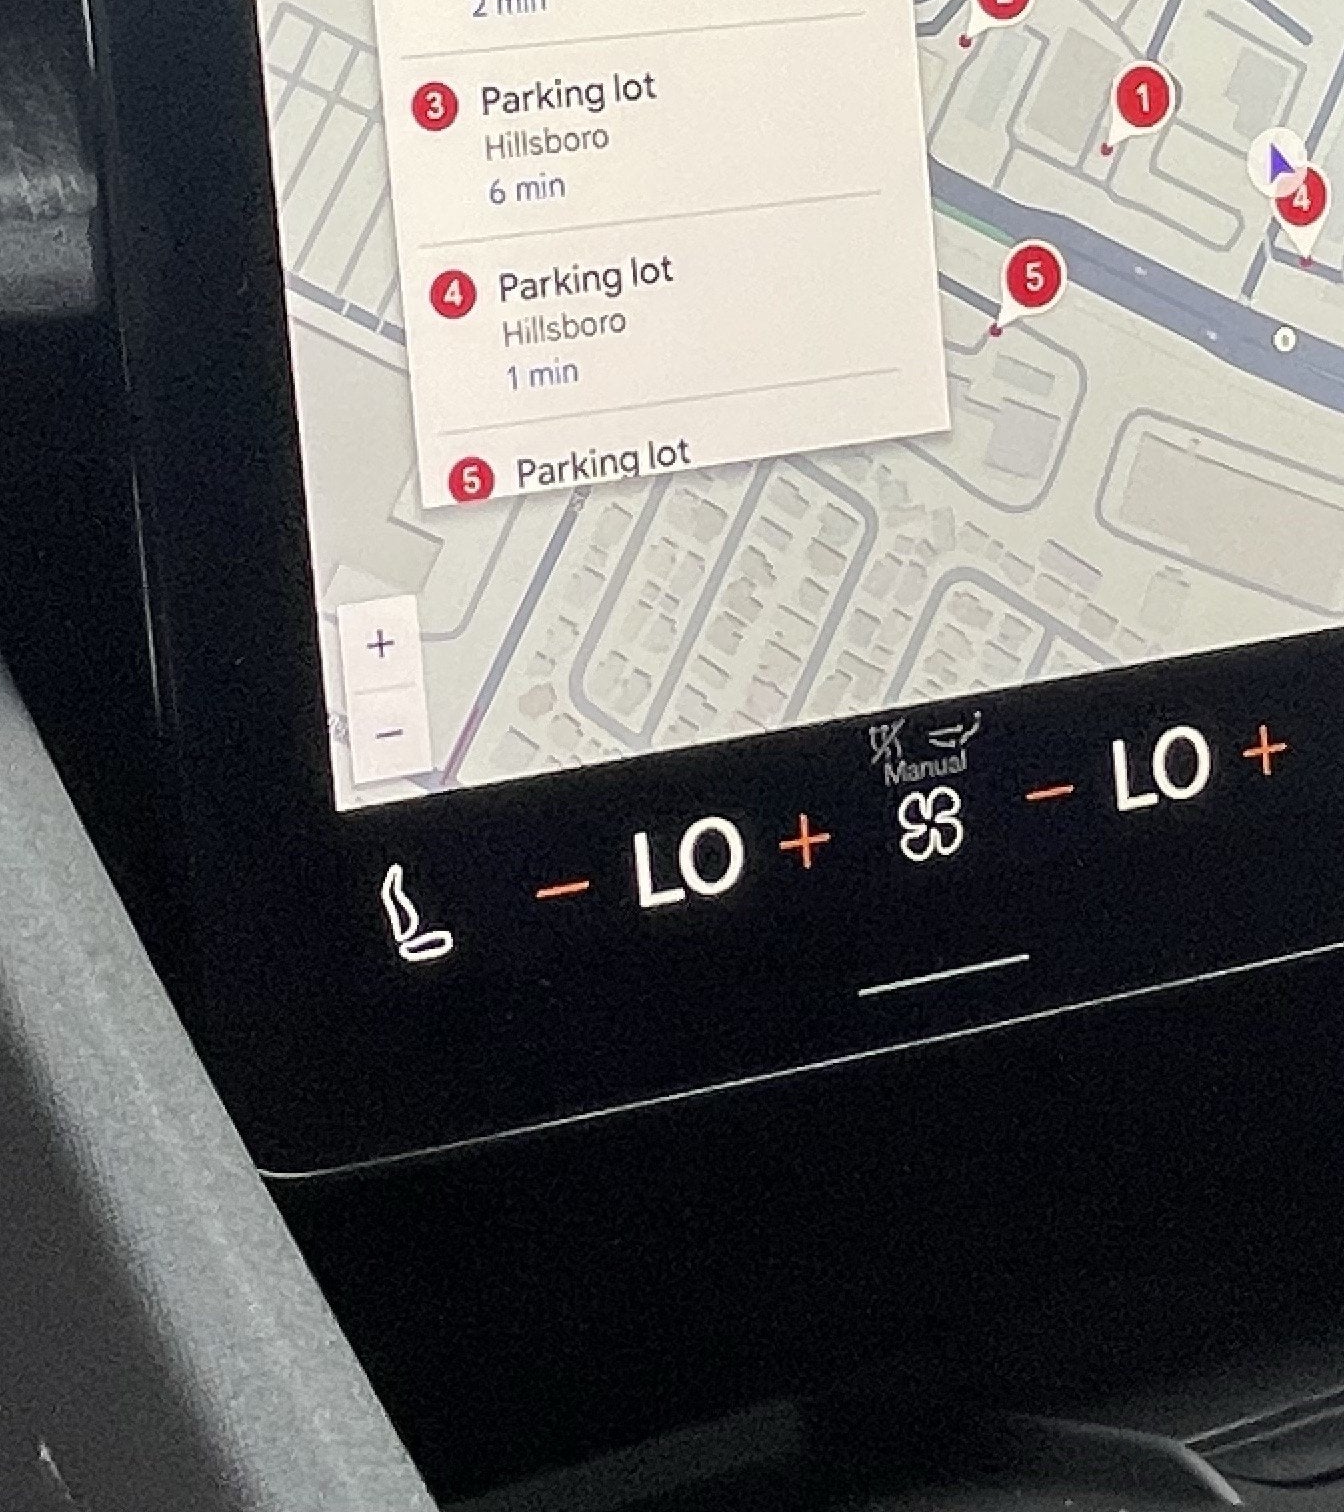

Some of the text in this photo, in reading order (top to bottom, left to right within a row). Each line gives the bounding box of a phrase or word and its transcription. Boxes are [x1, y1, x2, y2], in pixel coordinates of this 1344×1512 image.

[425, 91, 445, 121] 3
[480, 72, 657, 116] Parking lot
[1135, 83, 1151, 112] 1
[485, 127, 610, 161] Hillsboro
[490, 174, 566, 205] 6 min
[1292, 185, 1311, 211] 4
[444, 279, 464, 307] 4
[499, 256, 674, 302] Parking lot
[1025, 263, 1044, 291] 5
[502, 311, 627, 348] Hillsboro
[506, 358, 579, 390] 1 min
[463, 464, 480, 492] 5
[517, 438, 690, 488] Parking lot
[883, 752, 968, 787] Manual
[1112, 725, 1212, 811] LO
[633, 816, 745, 907] LO
